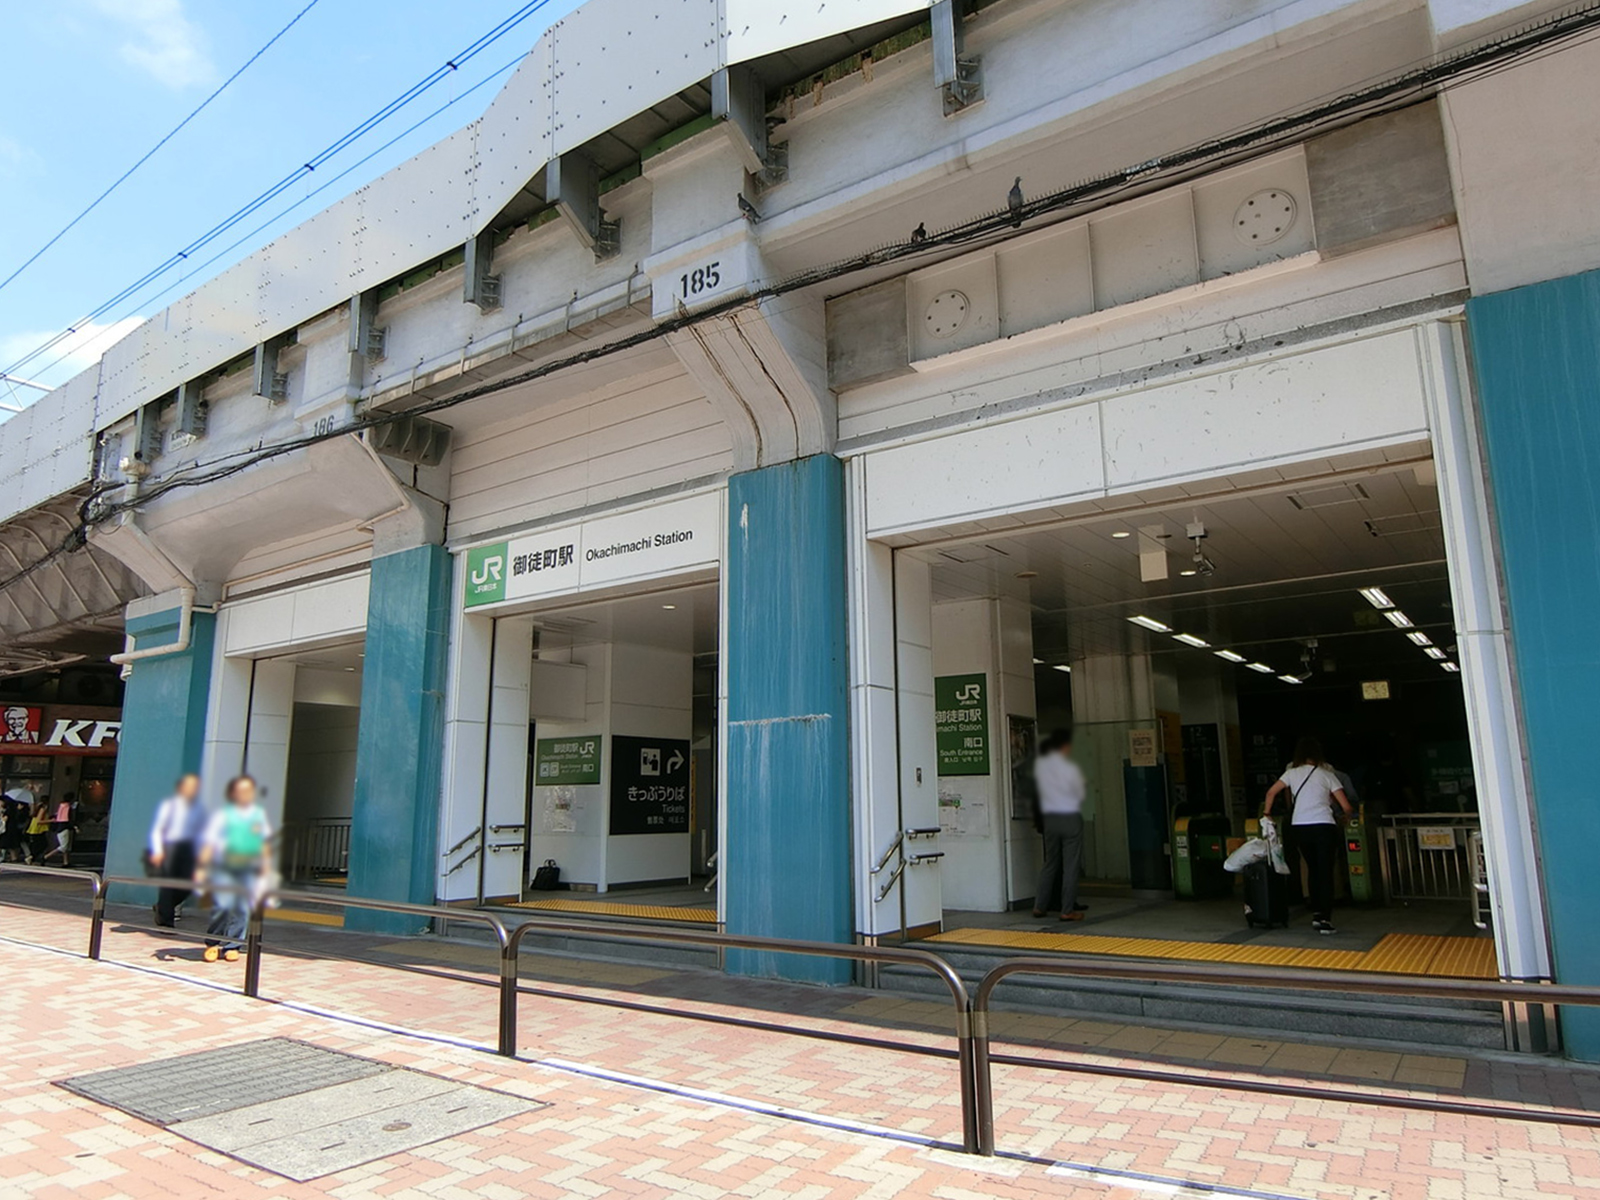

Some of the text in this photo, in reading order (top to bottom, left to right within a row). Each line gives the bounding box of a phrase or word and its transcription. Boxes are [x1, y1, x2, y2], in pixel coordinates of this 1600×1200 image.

[681, 261, 720, 298] 185
[314, 415, 335, 436] 186
[586, 530, 693, 562] Okachimachi Station
[513, 544, 574, 577] 御徒町駅
[471, 555, 503, 584] JR
[955, 683, 981, 700] JR
[45, 719, 121, 748] KF
[958, 723, 982, 732] Station
[579, 741, 595, 754] JR
[963, 737, 984, 748] 南口
[957, 748, 984, 757] Entrance
[627, 785, 686, 802] きっぷうりば
[662, 803, 685, 814] Tickets
